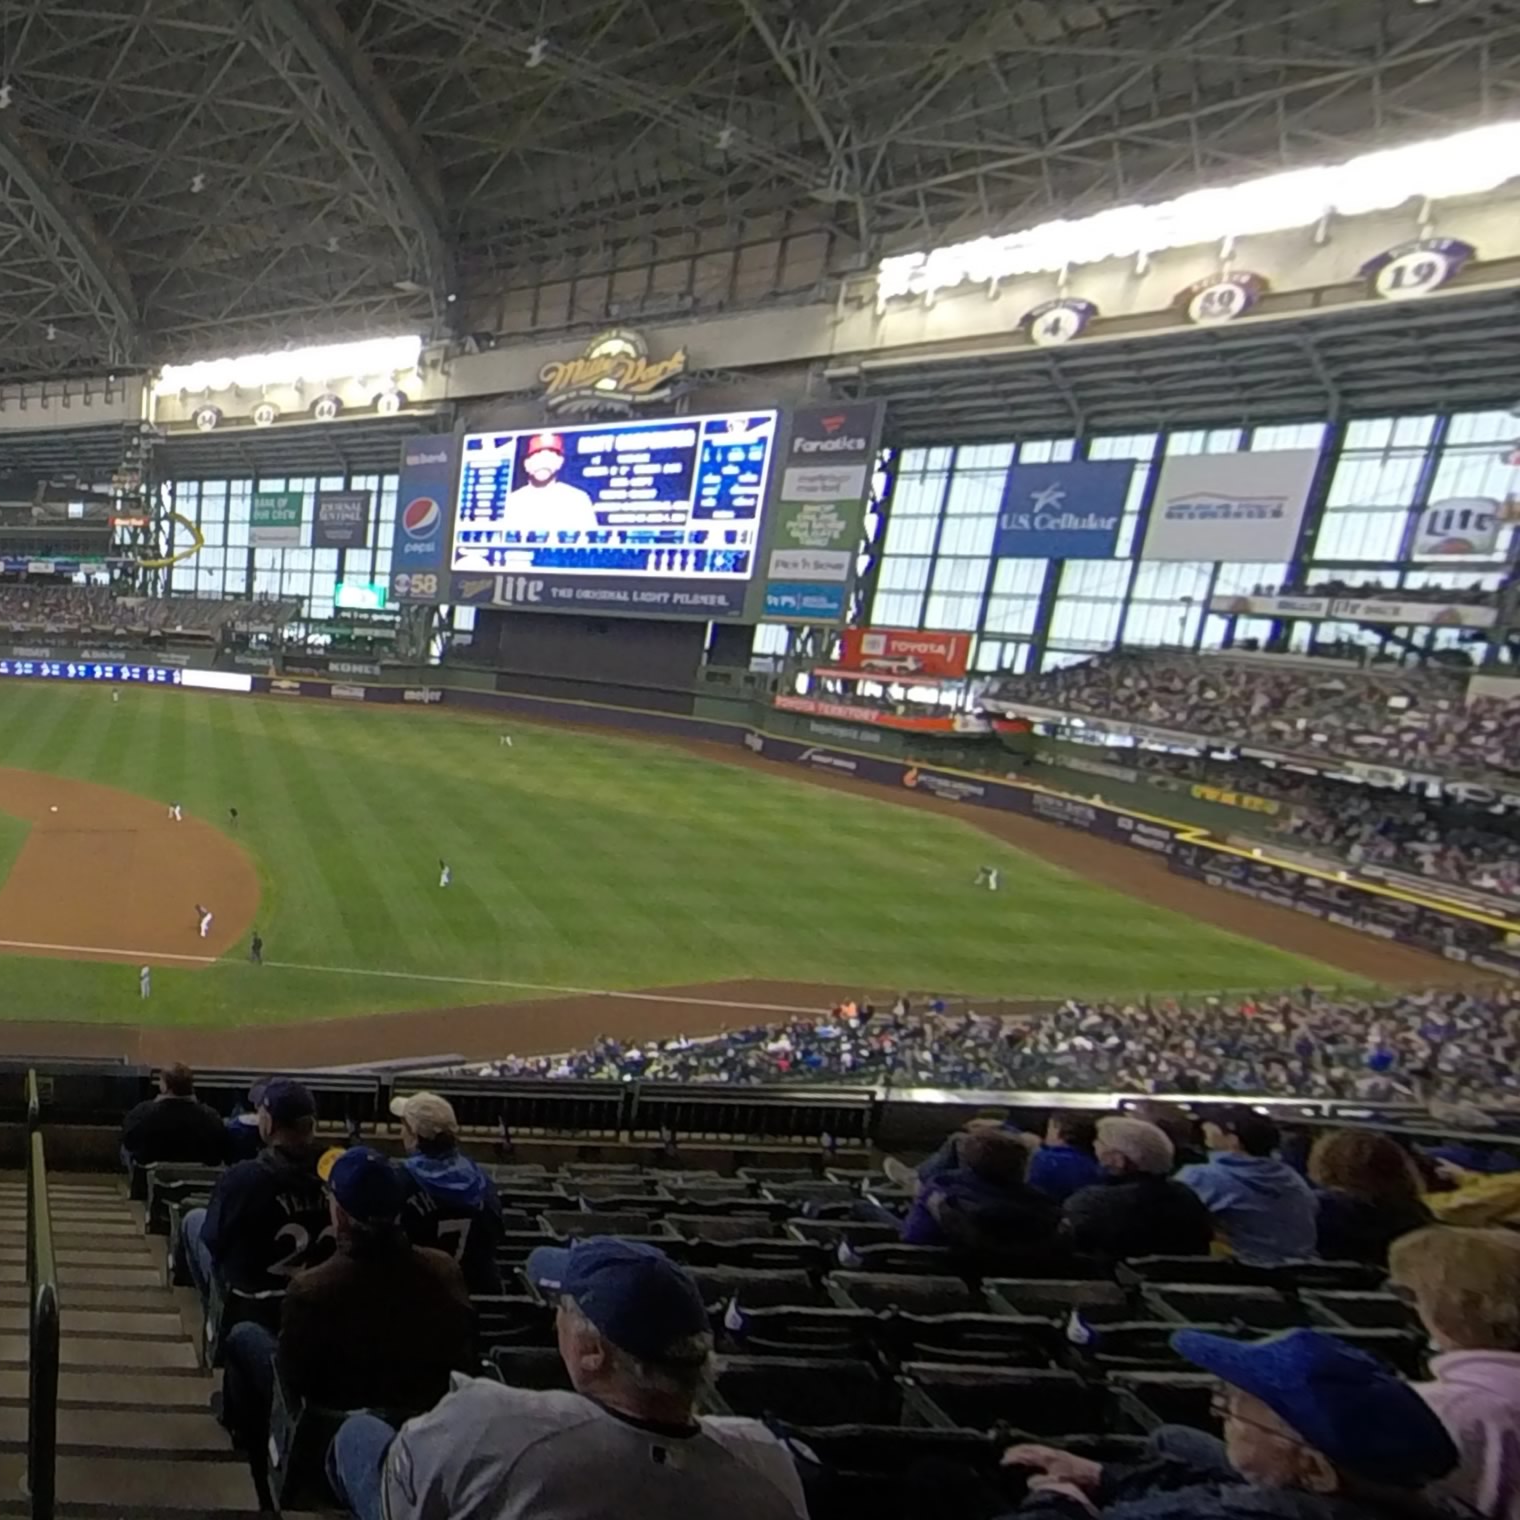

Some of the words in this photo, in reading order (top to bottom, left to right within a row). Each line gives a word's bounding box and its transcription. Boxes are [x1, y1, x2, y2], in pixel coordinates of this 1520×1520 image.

[1389, 262, 1437, 289] 19
[1045, 316, 1060, 338] 4
[792, 435, 866, 453] Fanatics
[1033, 512, 1118, 531] Cellular
[1425, 508, 1495, 537] Lite
[404, 542, 436, 554] pepsi
[410, 573, 438, 595] 58
[491, 574, 544, 606] Lite
[889, 639, 948, 655] TOYOTA
[403, 687, 443, 704] meijer
[816, 701, 879, 721] TERRITORY
[436, 1217, 473, 1264] 7
